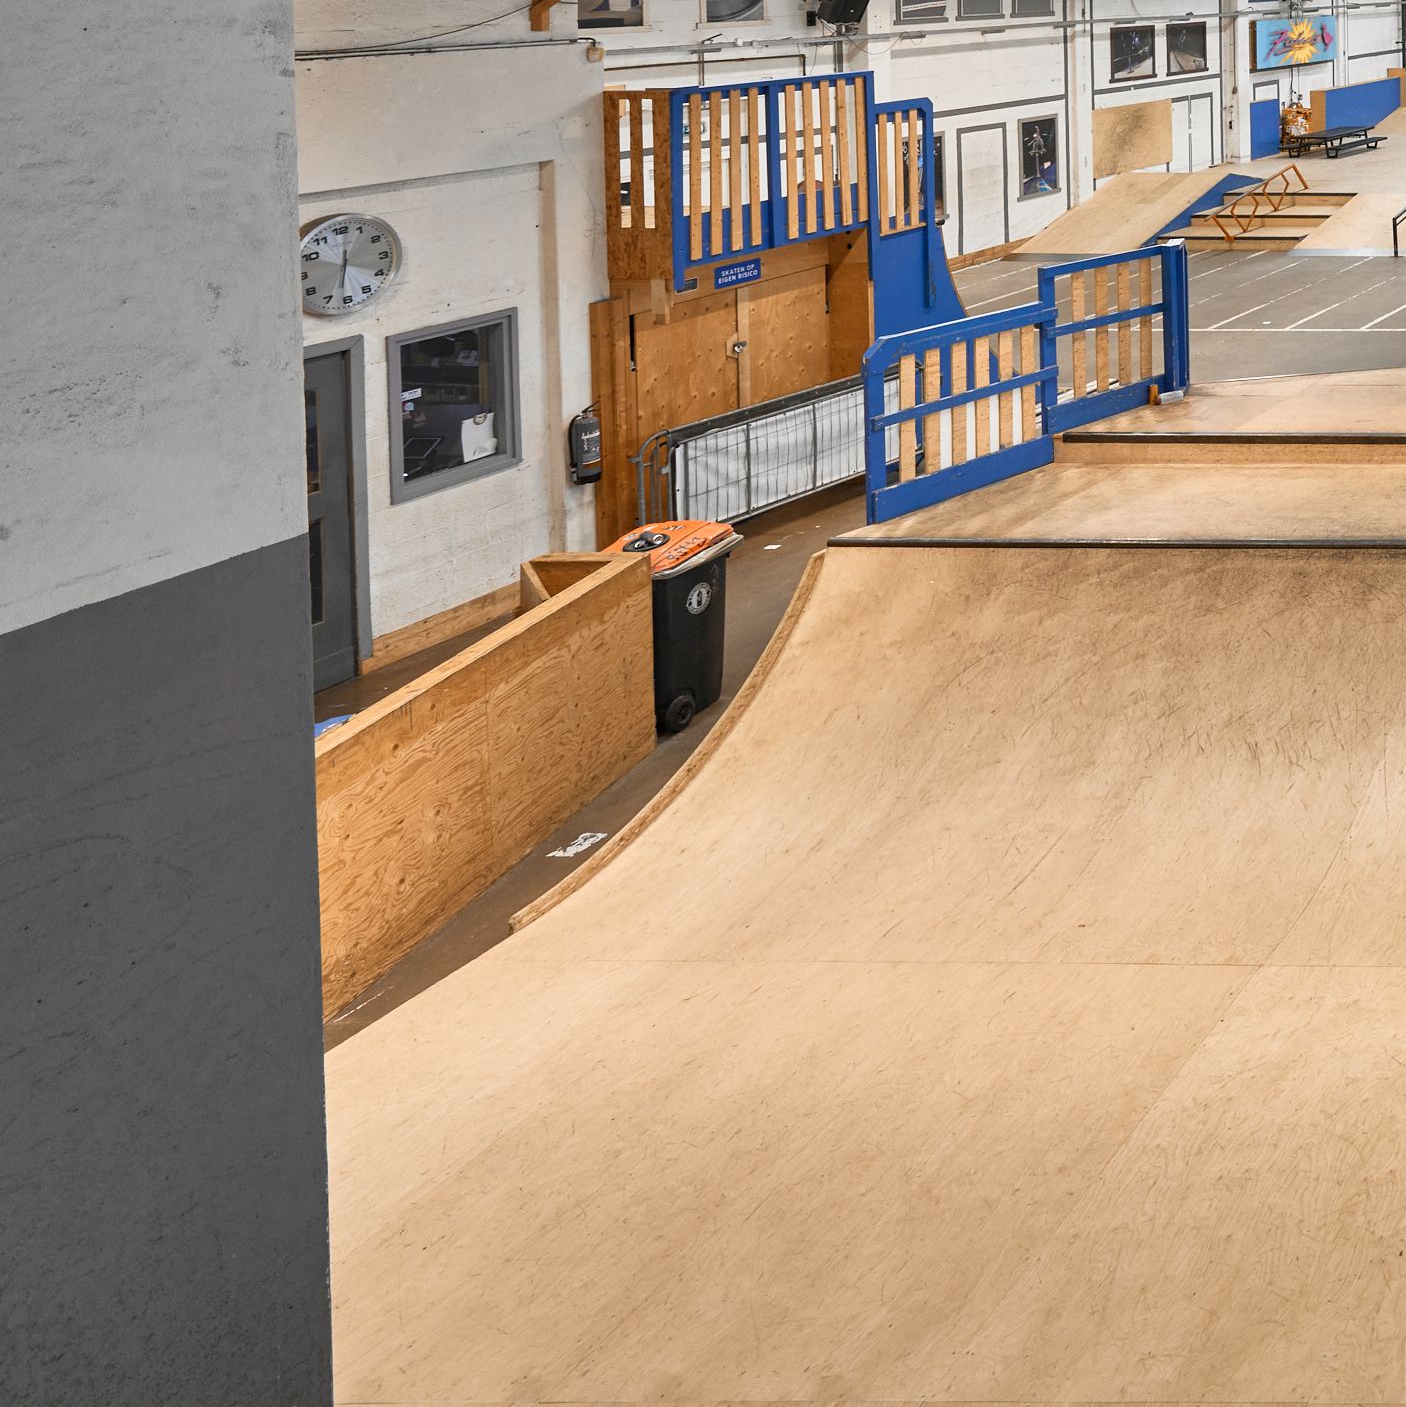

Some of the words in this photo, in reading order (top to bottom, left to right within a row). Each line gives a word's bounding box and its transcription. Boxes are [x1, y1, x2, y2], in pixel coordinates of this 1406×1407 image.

[332, 226, 349, 235] 12
[356, 226, 363, 234] 1
[313, 236, 328, 246] 11
[371, 235, 381, 244] 2
[301, 251, 319, 262] 10
[378, 251, 389, 260] 3
[374, 269, 385, 277] 4
[718, 275, 736, 284] EIGEN
[738, 269, 758, 279] RISICO
[721, 267, 745, 277] SKATEN
[305, 286, 316, 296] 8
[361, 285, 372, 294] 5
[323, 295, 334, 304] 7
[343, 295, 353, 304] 6
